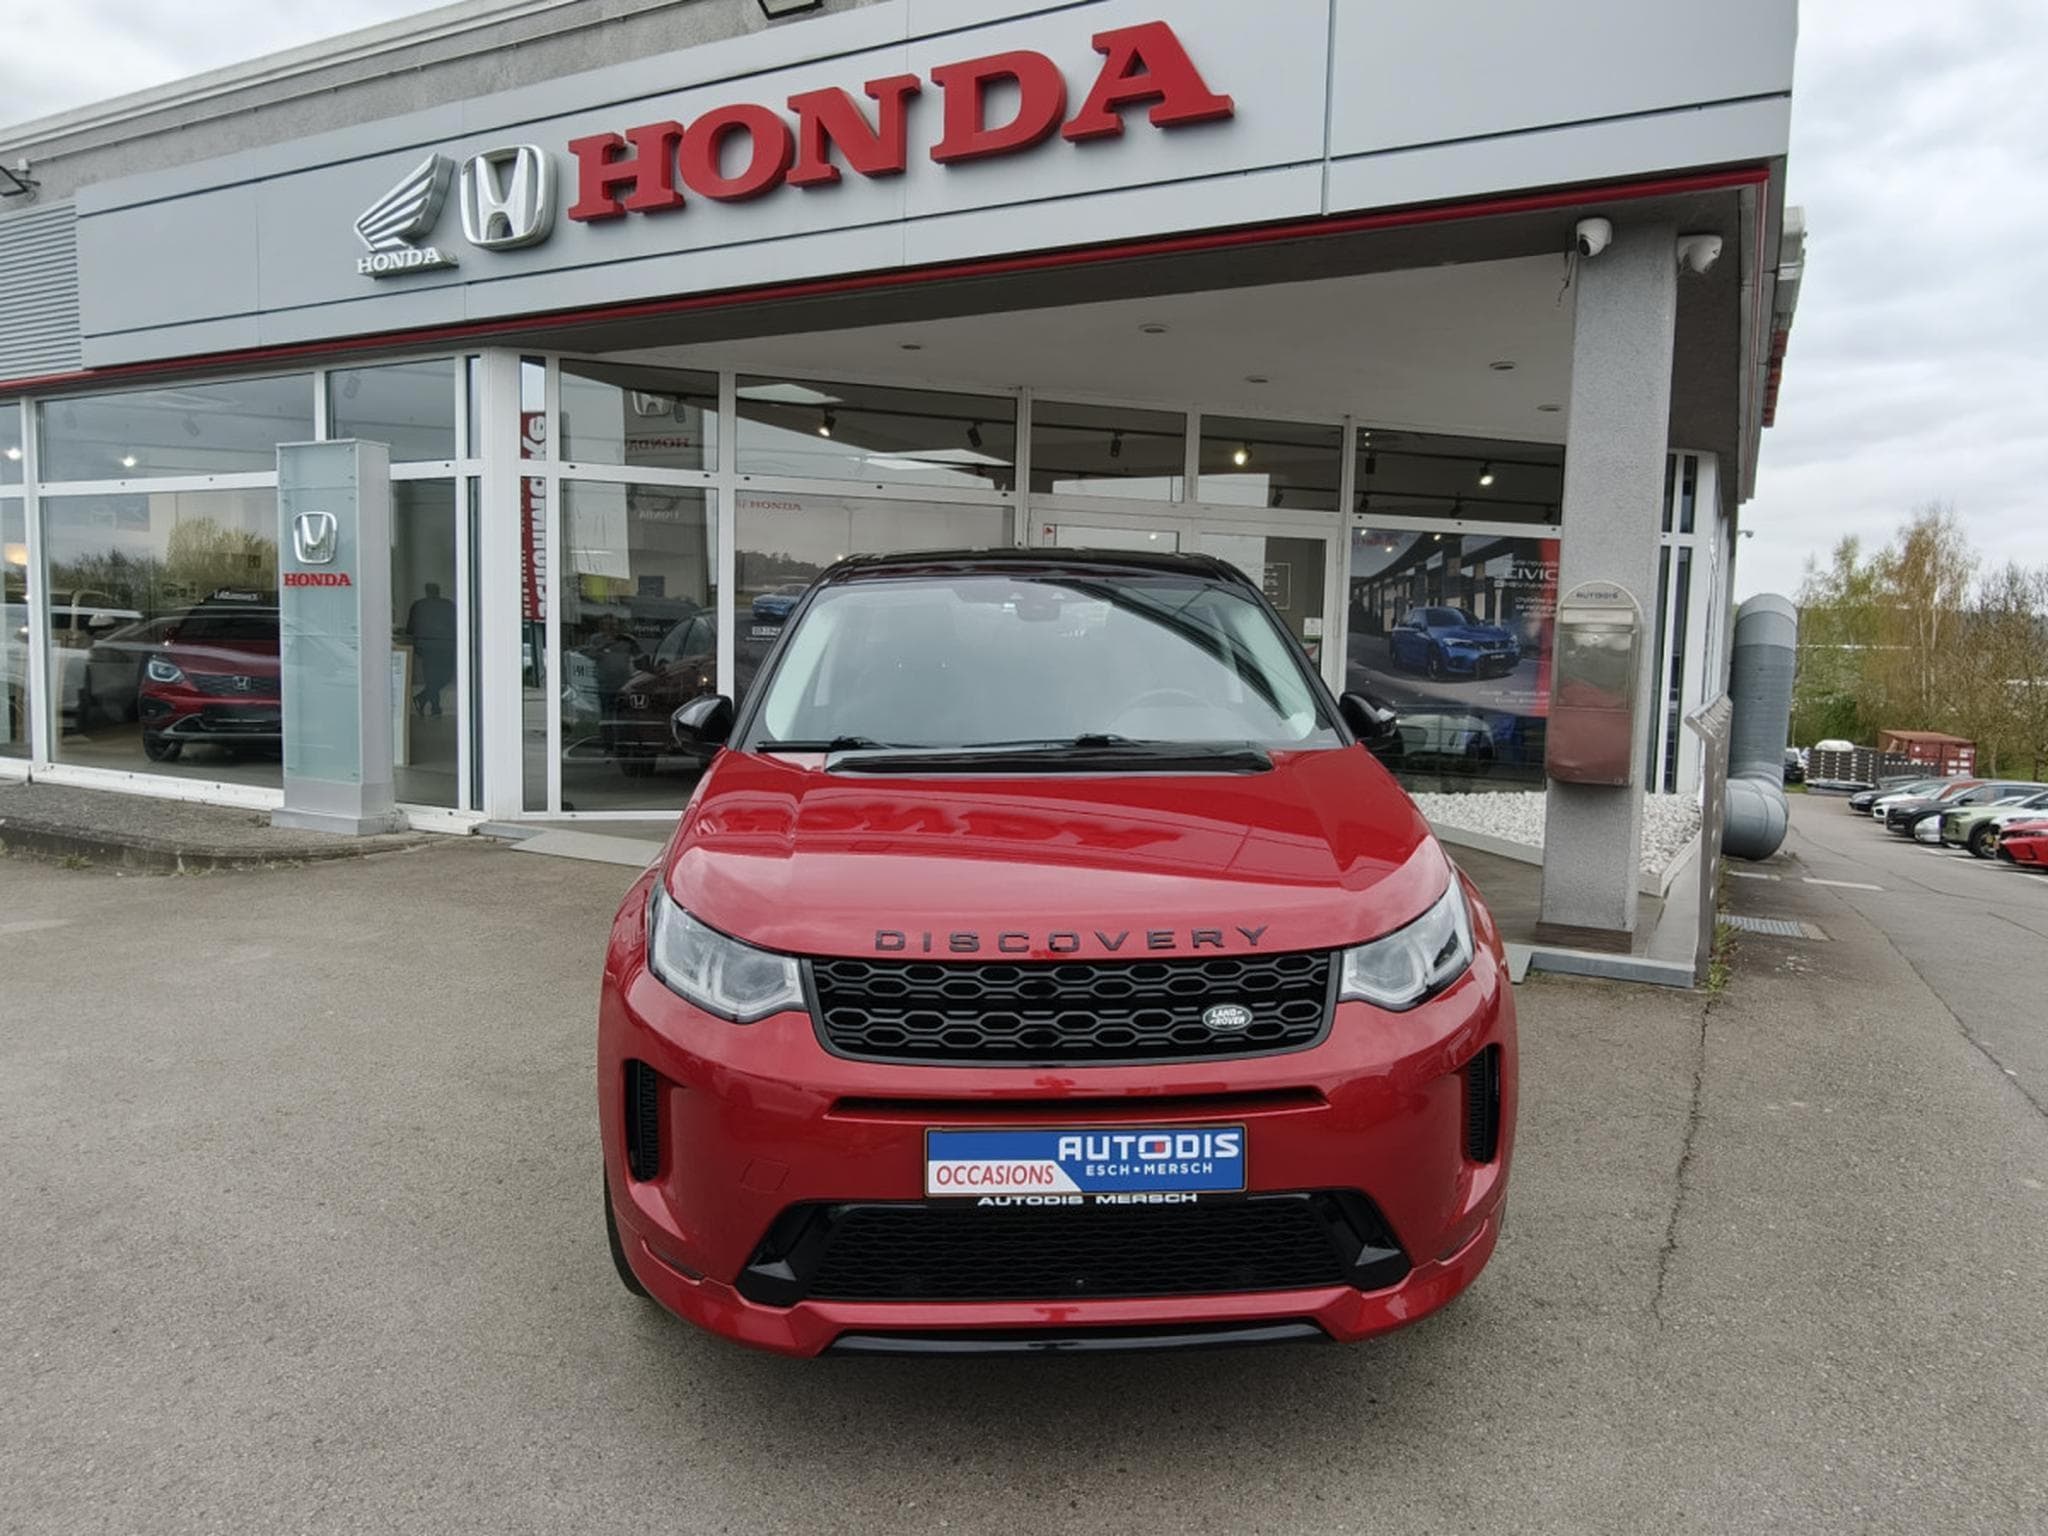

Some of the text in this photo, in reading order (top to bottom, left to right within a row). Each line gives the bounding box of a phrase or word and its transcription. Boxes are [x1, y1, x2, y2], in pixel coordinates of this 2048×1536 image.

[568, 20, 1233, 223] HONDA
[357, 247, 441, 274] HONDA
[750, 500, 802, 511] HONDA
[283, 572, 352, 587] HONDA
[1504, 568, 1558, 581] CIVIC
[875, 925, 1270, 953] DISCOVERY
[1058, 1133, 1239, 1161] AUTODIS
[936, 1165, 1054, 1185] OCCASIONS
[1086, 1162, 1213, 1177] ESCH MERSCH
[977, 1193, 1198, 1206] AUTODIS MERSCH
